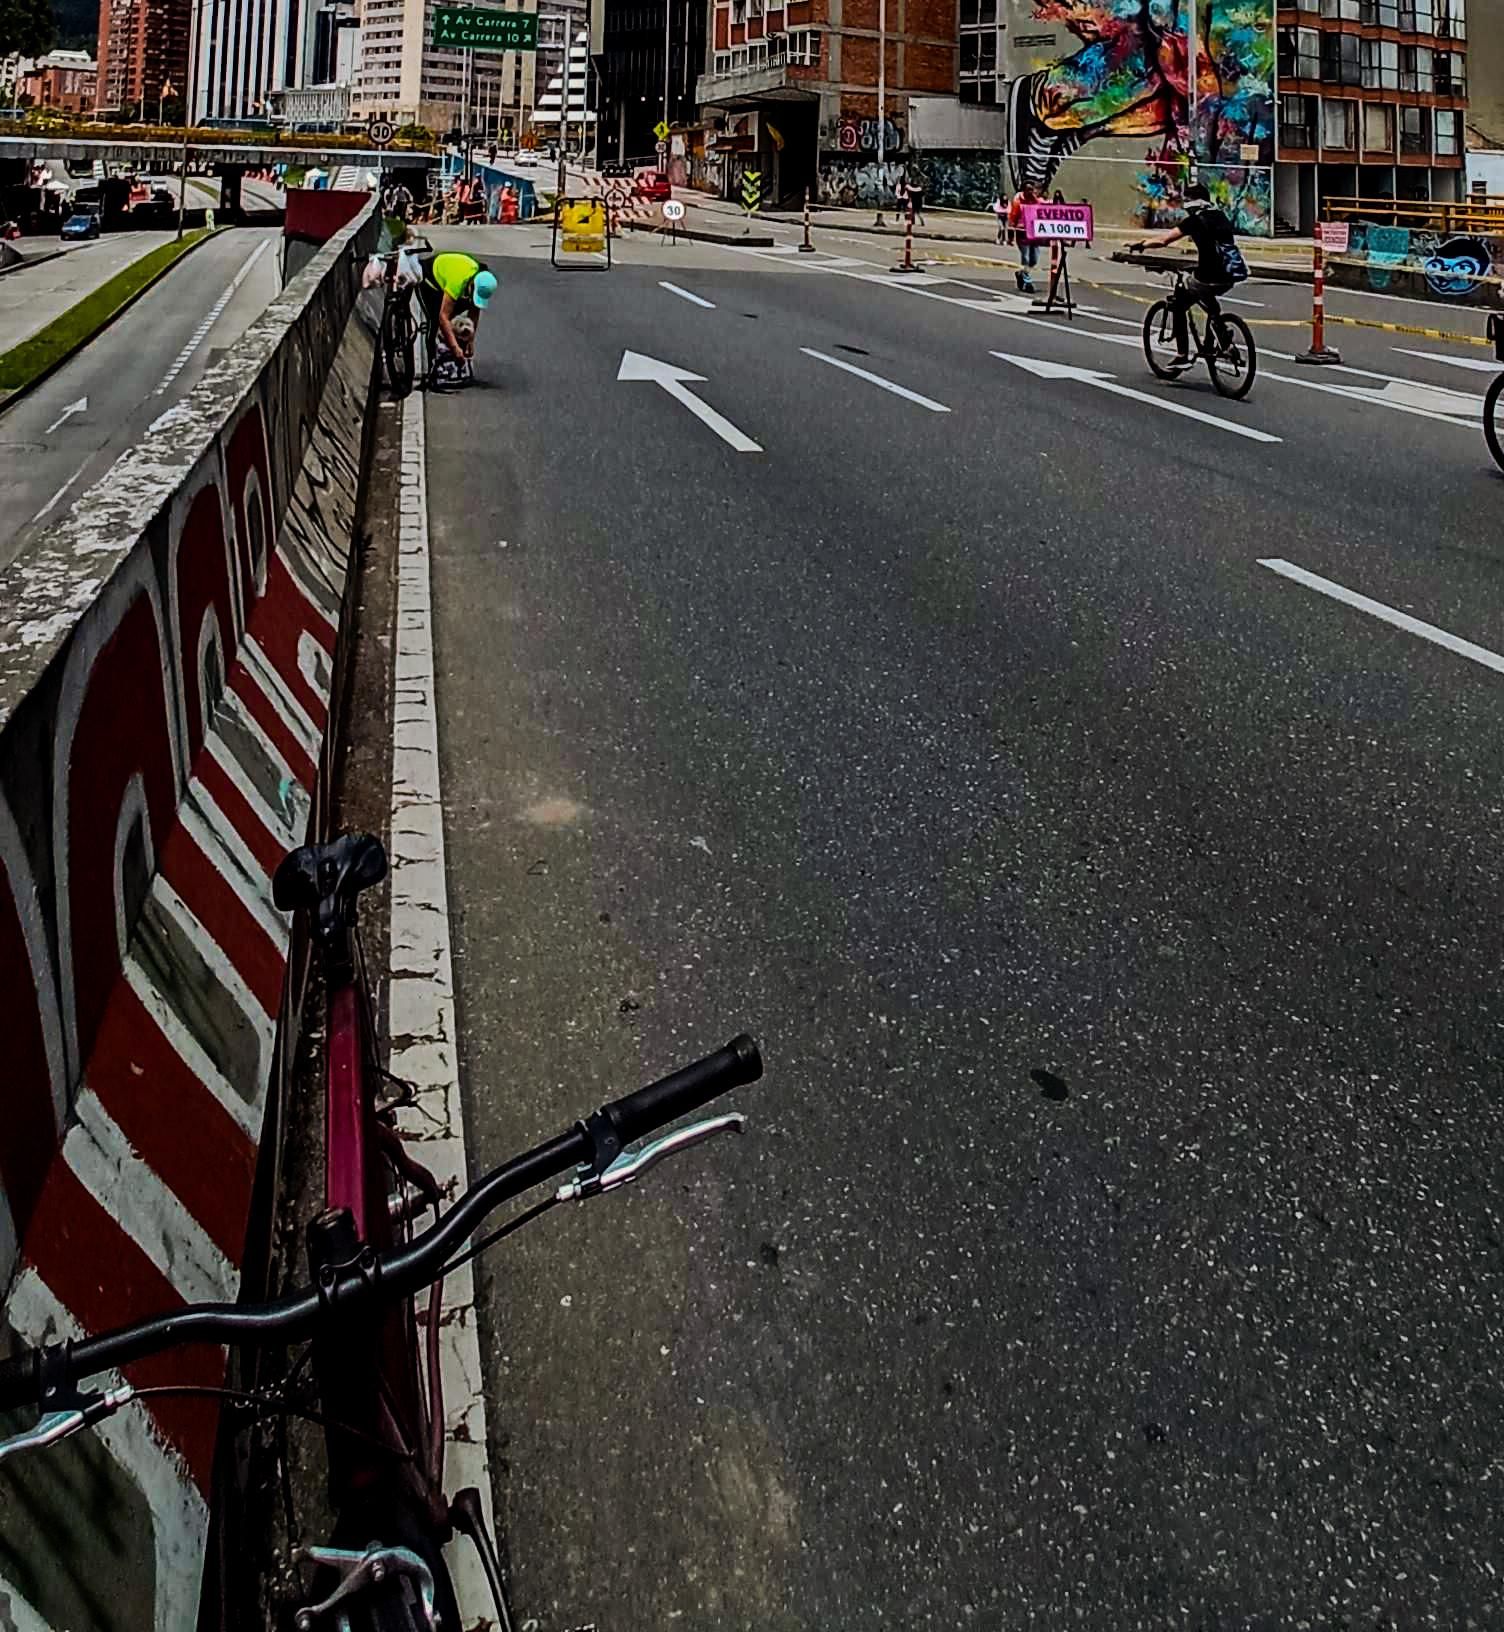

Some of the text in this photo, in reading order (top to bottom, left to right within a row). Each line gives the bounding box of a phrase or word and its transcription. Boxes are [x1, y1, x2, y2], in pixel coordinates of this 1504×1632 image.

[456, 15, 530, 28] Av Carrera 7
[441, 29, 519, 42] Av Carrera 10
[373, 125, 389, 138] 30
[667, 206, 681, 216] 30
[1036, 208, 1085, 221] EVENTO
[1038, 223, 1085, 234] A 100 m
